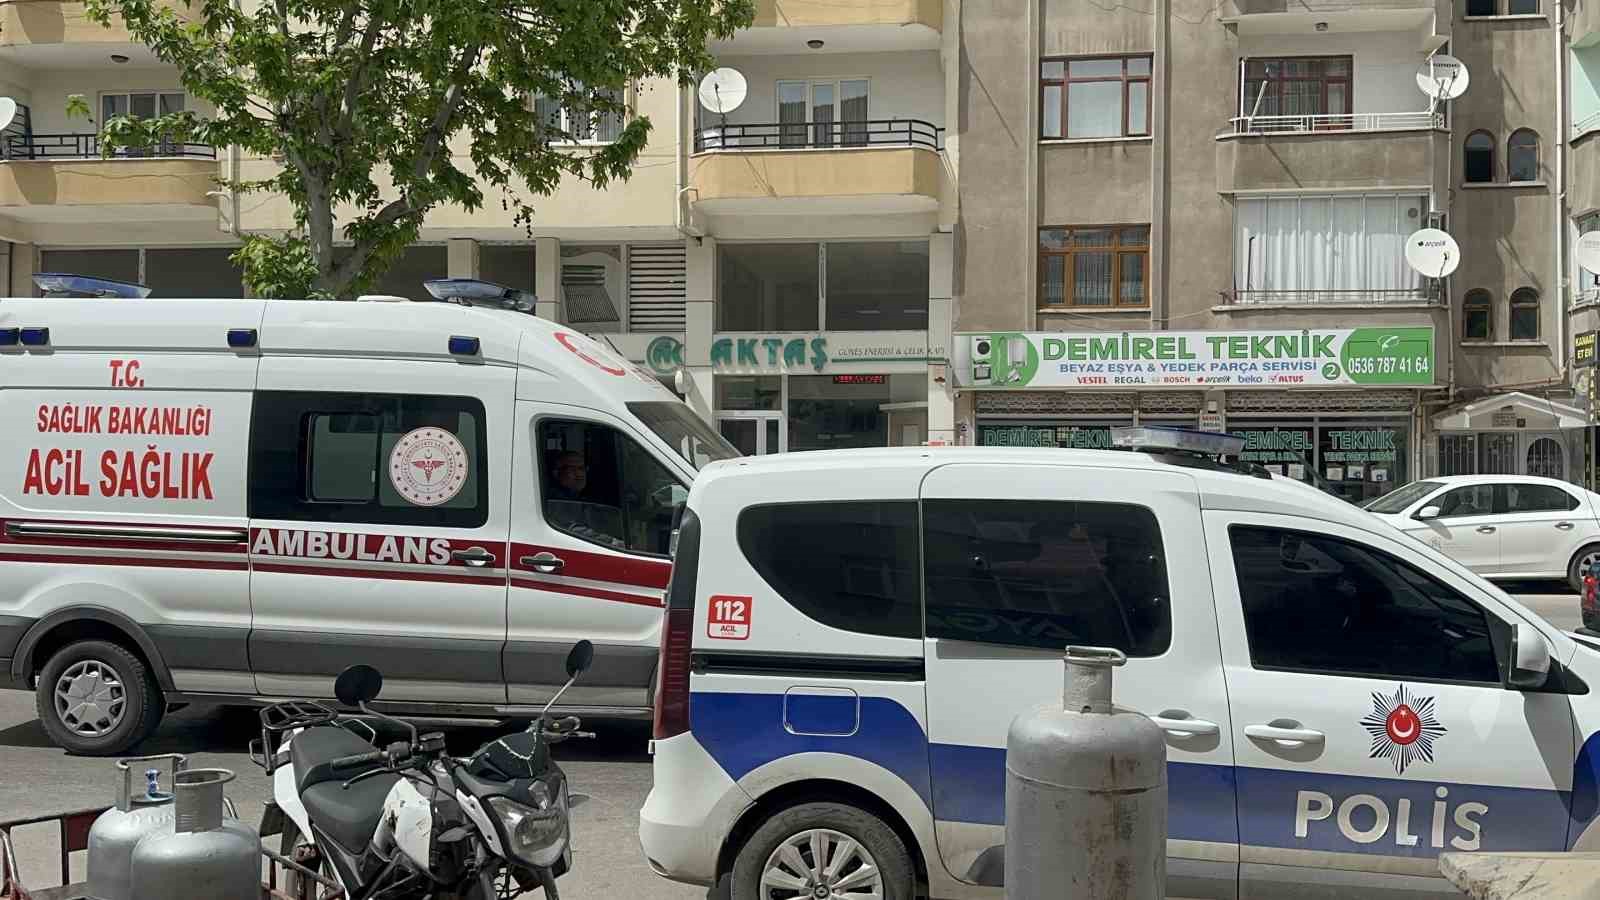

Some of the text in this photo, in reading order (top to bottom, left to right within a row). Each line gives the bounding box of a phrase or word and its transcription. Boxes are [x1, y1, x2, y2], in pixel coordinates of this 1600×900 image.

[710, 336, 827, 373] AKTAŞ
[1042, 330, 1336, 361] DEMİREL TEKNİK
[110, 360, 144, 387] T.C.
[1059, 360, 1317, 374] BEYAZ EŞYA & YEDEK PARÇA SERVİSİ
[1326, 366, 1337, 377] 2
[1348, 357, 1429, 373] 0536 787 41 64
[1077, 376, 1107, 384] VESTEL
[1114, 376, 1146, 384] REGAL
[1238, 375, 1263, 383] beko
[38, 402, 212, 436] SAĞLIK BAKANLIĞI
[1064, 429, 1113, 448] TEKN
[1328, 425, 1395, 450] TEKNİK
[99, 444, 214, 500] SAĞLIK
[251, 529, 450, 566] AMBULANS
[715, 600, 745, 622] 112
[1294, 786, 1489, 852] POLİS
